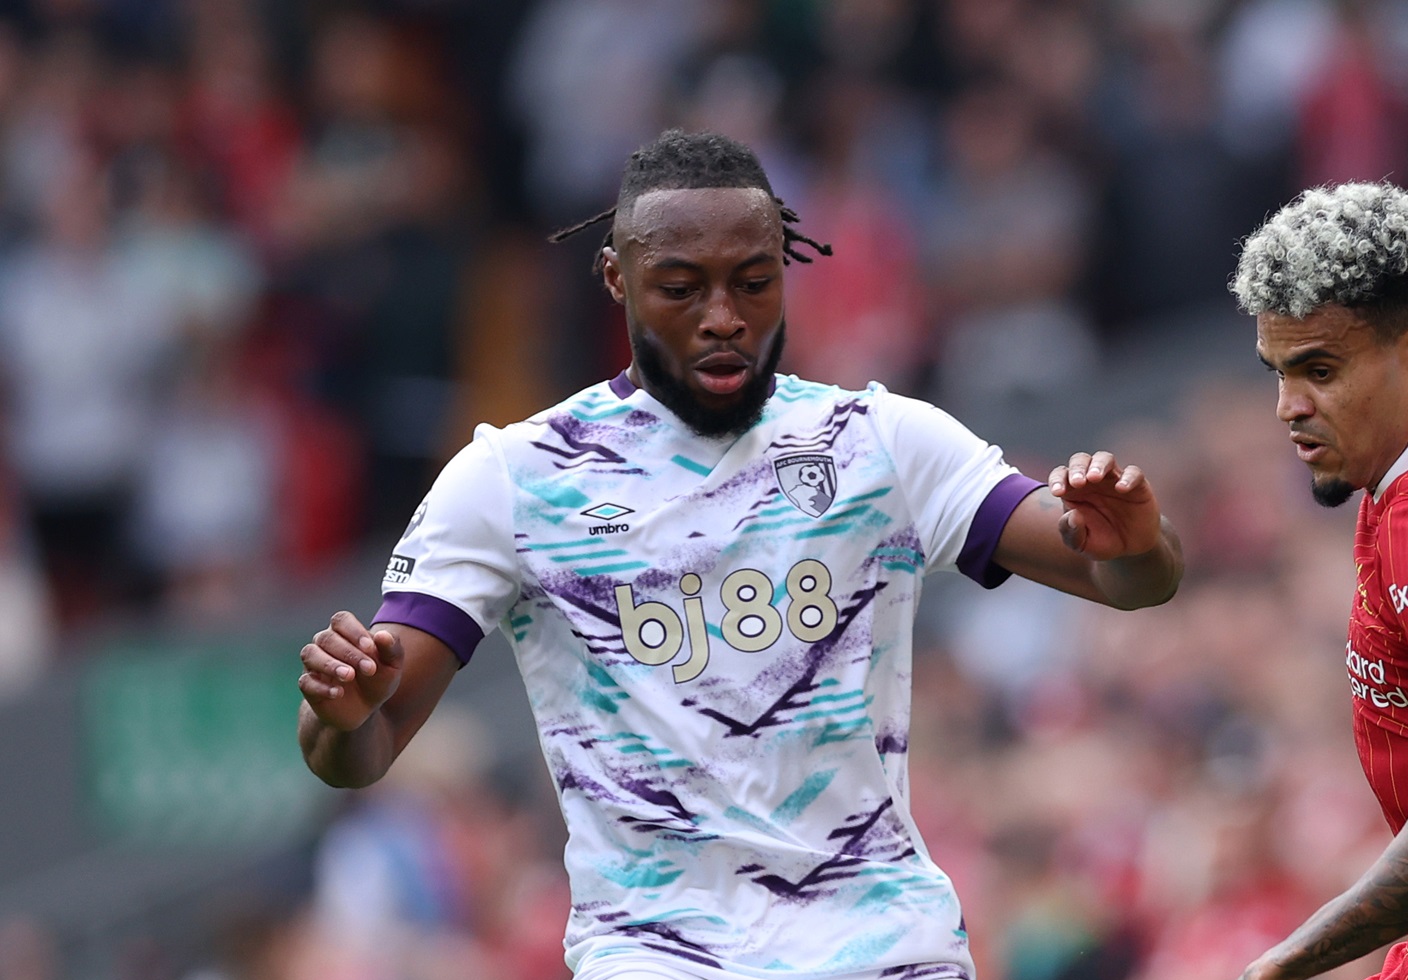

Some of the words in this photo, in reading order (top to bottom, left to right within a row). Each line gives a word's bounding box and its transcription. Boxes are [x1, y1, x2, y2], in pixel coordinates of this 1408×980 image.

[787, 456, 833, 464] BOURNEMOUTH
[589, 523, 630, 536] umbro
[614, 558, 838, 684] bj88
